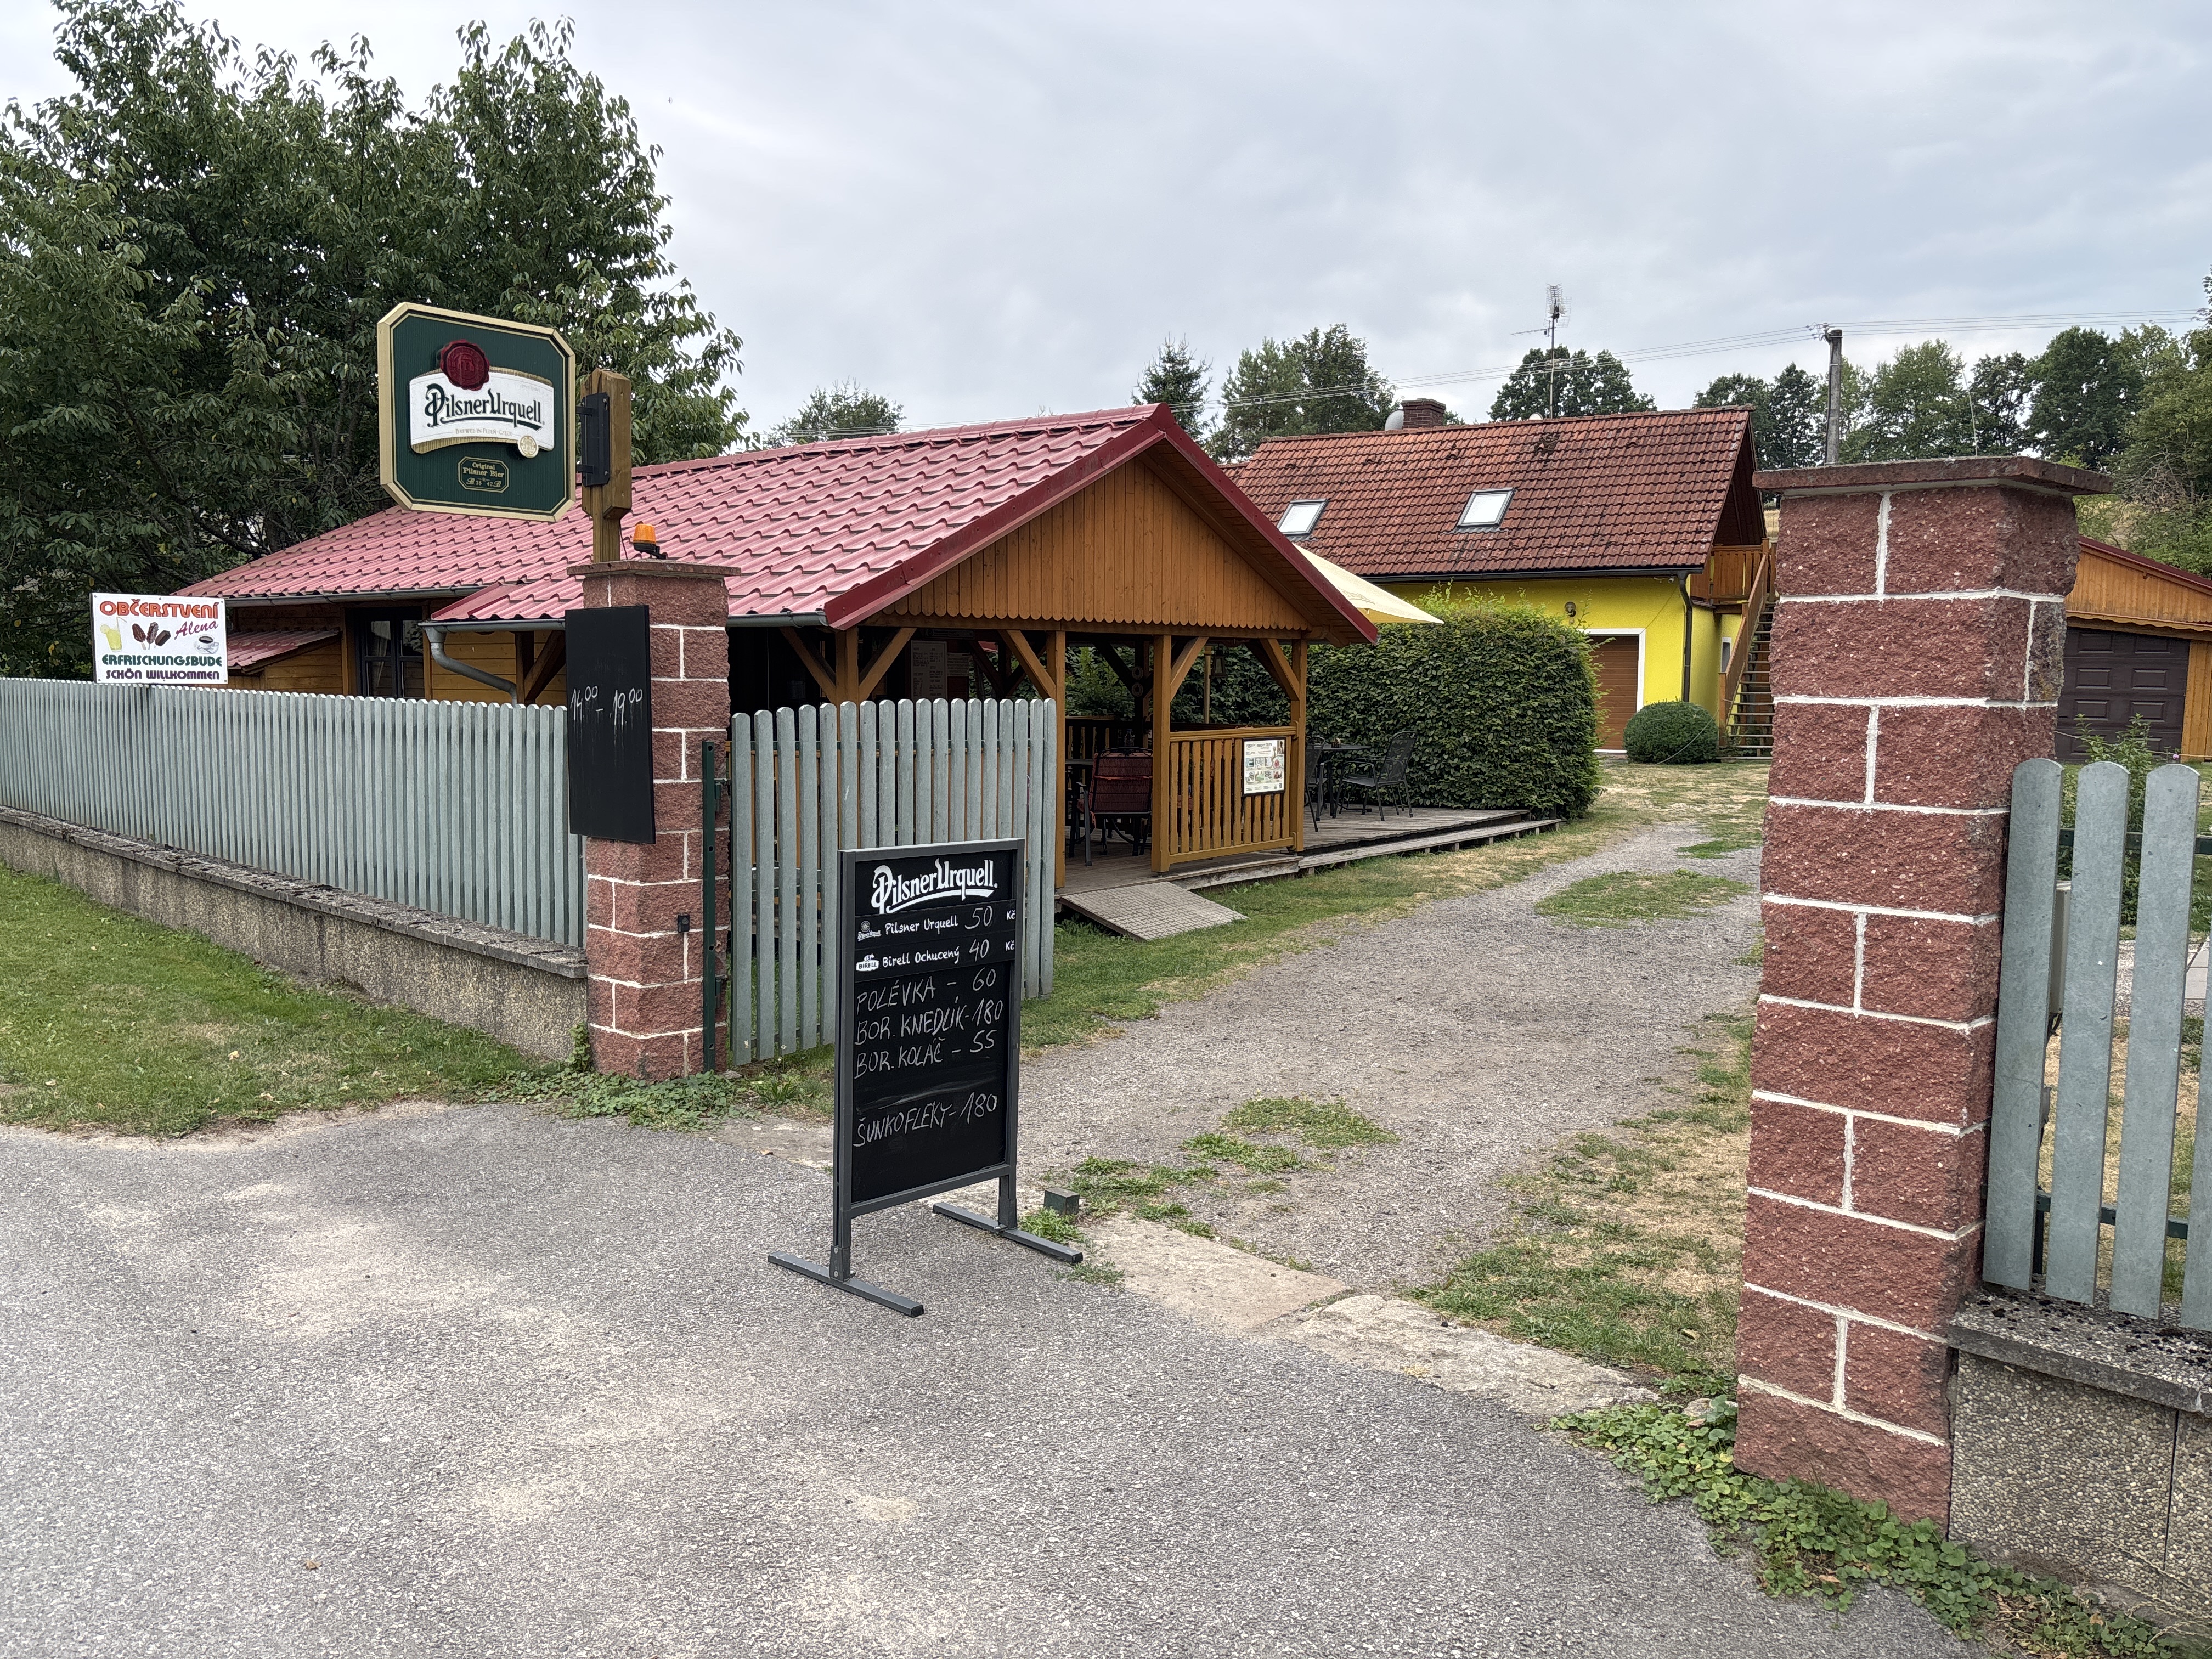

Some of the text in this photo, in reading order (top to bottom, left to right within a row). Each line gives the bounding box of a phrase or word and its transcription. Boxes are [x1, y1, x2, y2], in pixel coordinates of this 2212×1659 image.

[425, 383, 541, 428] Pilsner Urquell
[462, 467, 488, 476] Pilsner
[100, 599, 219, 619] OBČERSTVENÍ
[174, 620, 219, 640] Alena
[101, 654, 222, 667] ERFRISCHUNGSBUDE
[106, 668, 220, 680] SCHÖN WILLKOMMEN
[871, 858, 994, 915] Pilsner Urquell
[884, 905, 1015, 935] Pilsner Urquell 50 Kč
[882, 939, 1015, 968] Birell Ochucený 40 Kč
[856, 976, 936, 1015] POLÉVKA
[972, 967, 996, 991] 60
[972, 998, 1003, 1026] 180
[854, 1051, 895, 1080] BOR.
[898, 1036, 946, 1068] KOLÁČ
[969, 1030, 997, 1053] 55
[959, 1091, 997, 1124] 180
